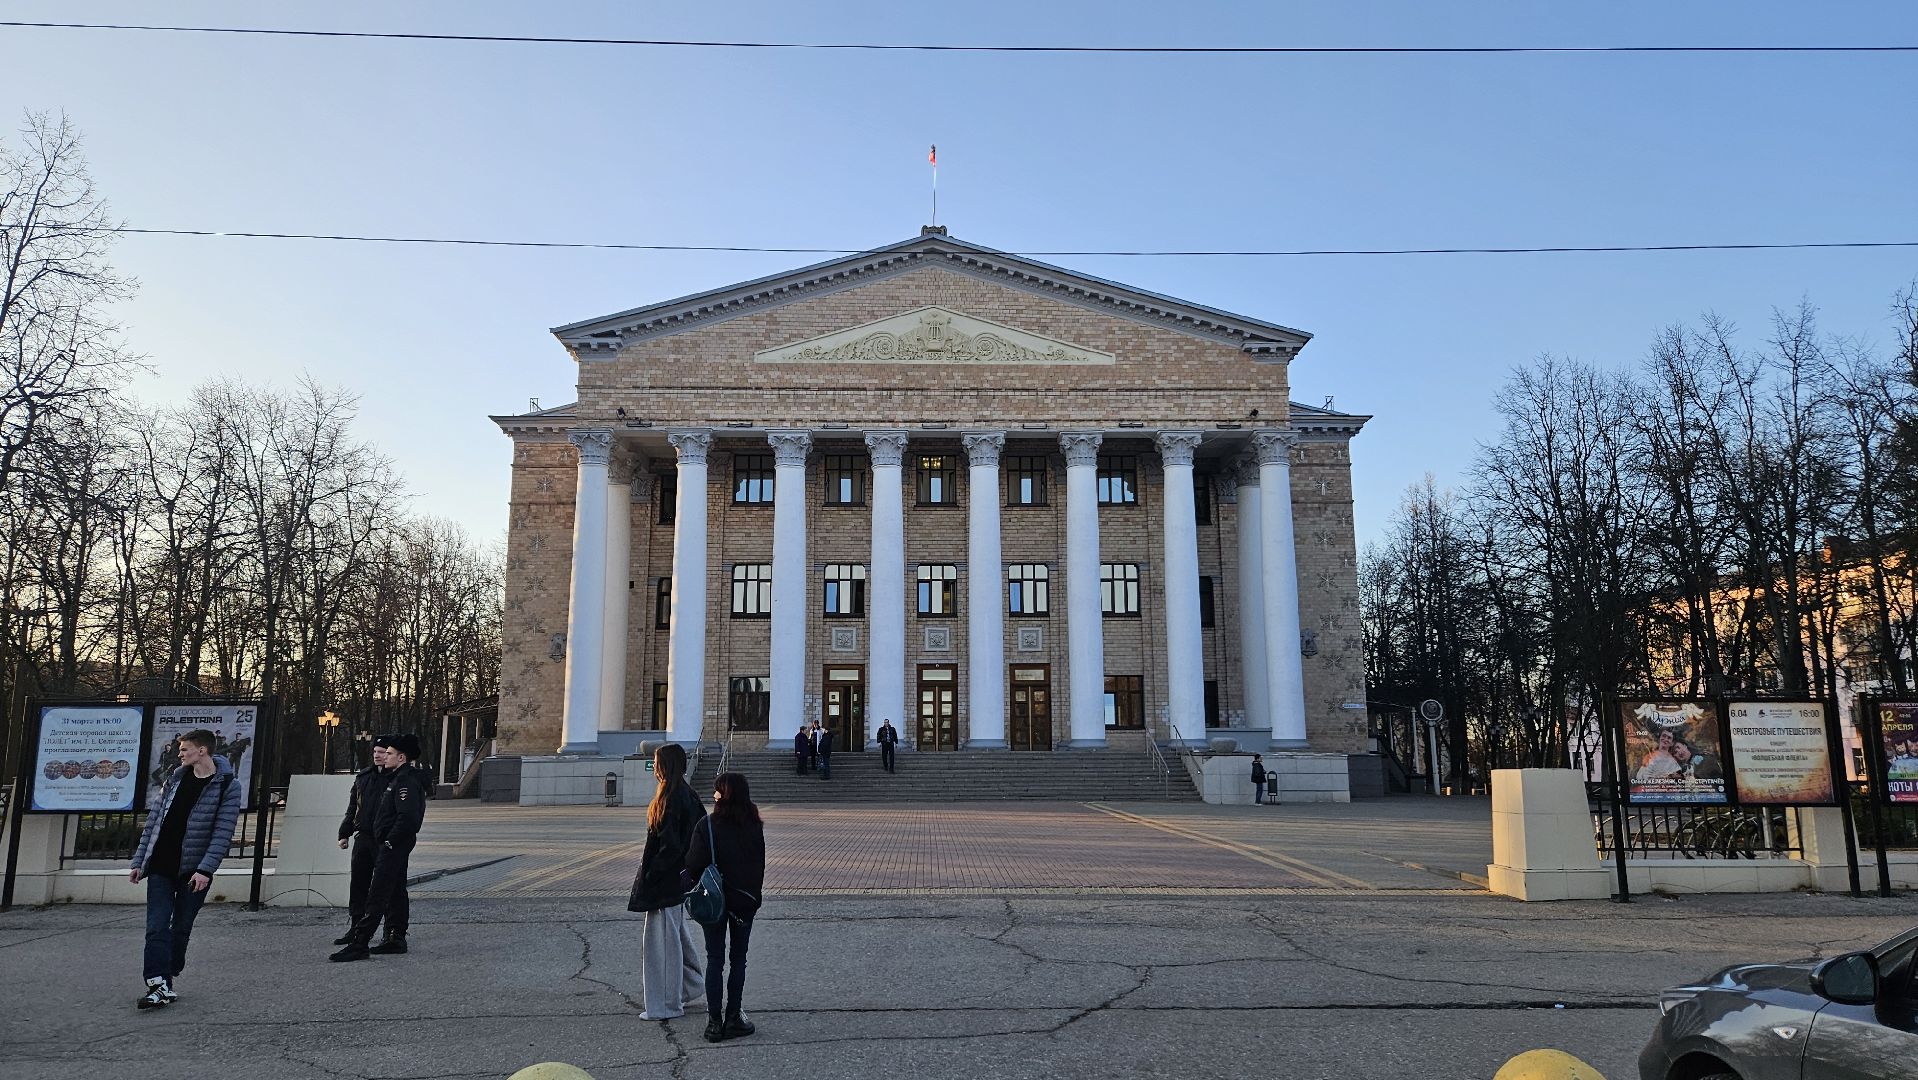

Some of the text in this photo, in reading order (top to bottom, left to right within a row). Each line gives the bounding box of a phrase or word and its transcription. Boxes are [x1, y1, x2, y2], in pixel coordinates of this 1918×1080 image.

[159, 716, 223, 724] PALESTRINA
[236, 710, 254, 723] 25
[1880, 711, 1894, 722] 12
[1732, 728, 1822, 736] ОРКЕСТРОВЫЕ ПУТЕШЕСТВИЯ
